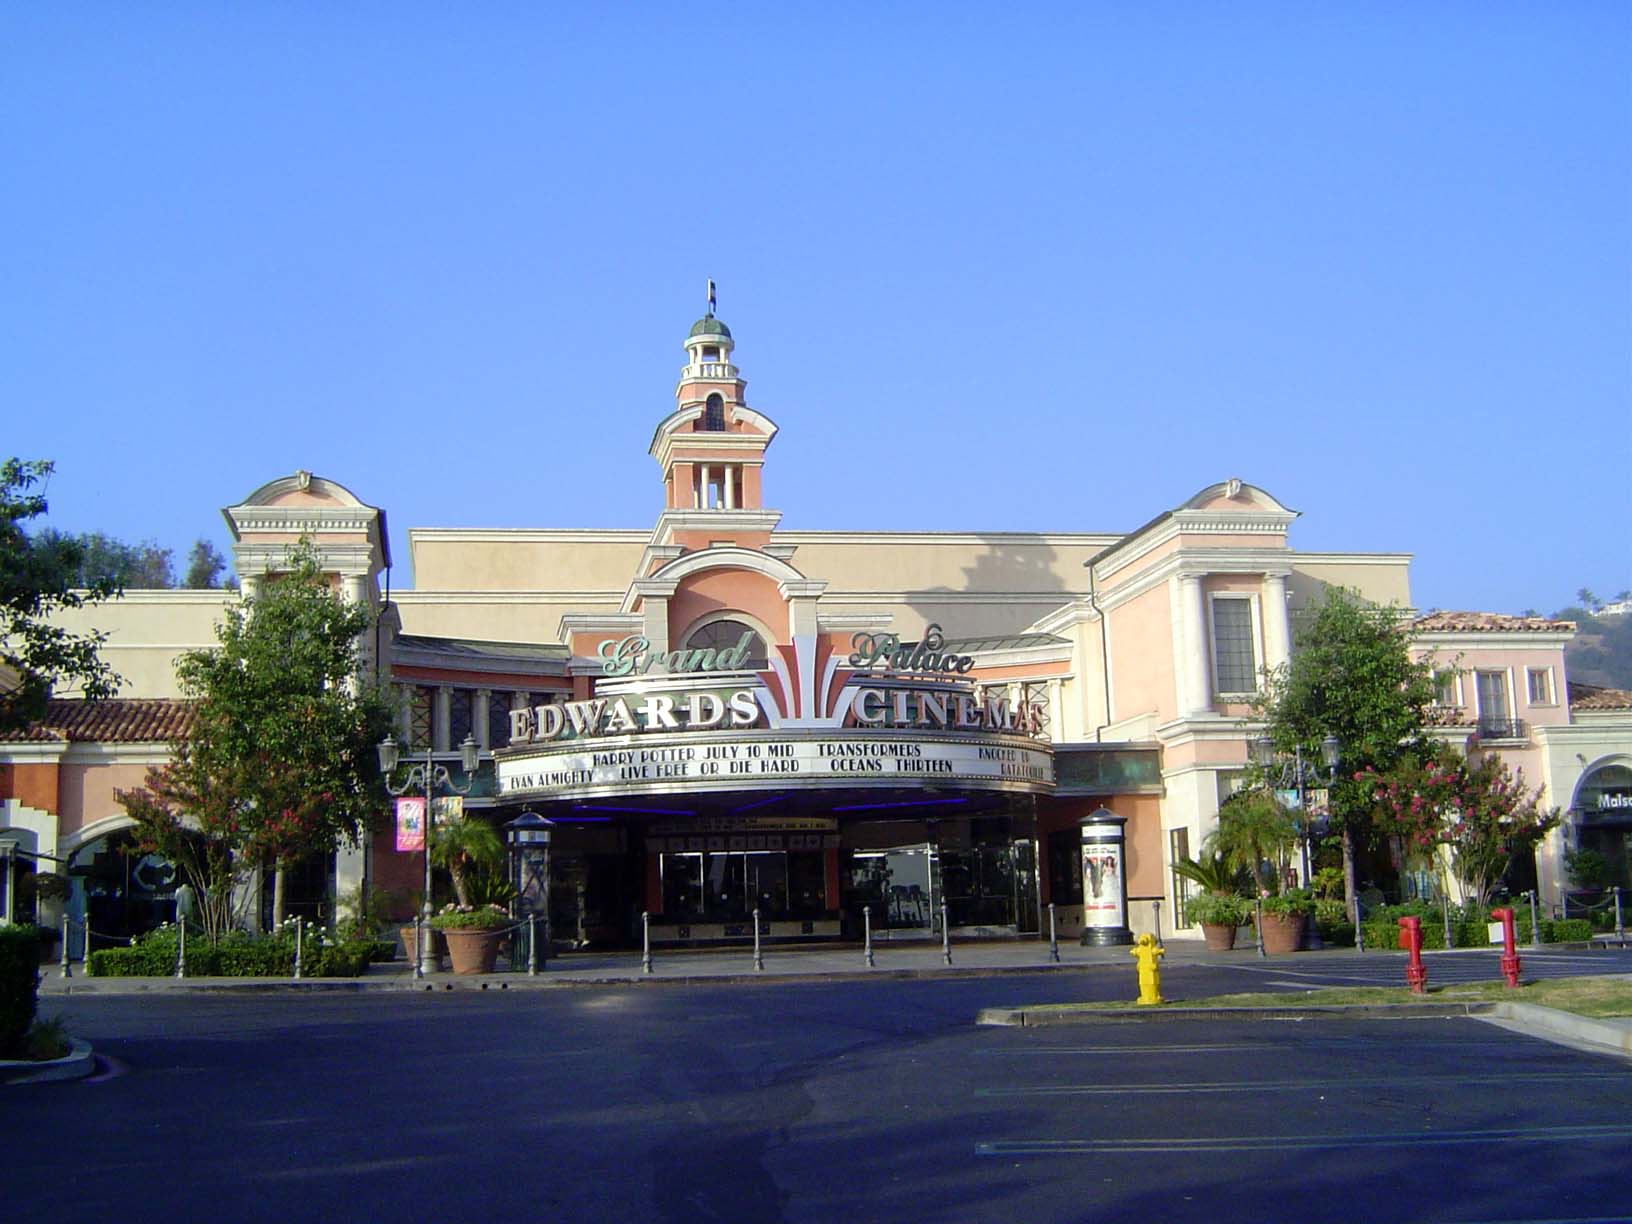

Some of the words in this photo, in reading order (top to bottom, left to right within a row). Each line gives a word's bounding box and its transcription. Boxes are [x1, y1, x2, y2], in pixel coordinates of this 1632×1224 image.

[598, 631, 756, 676] Grand
[849, 622, 976, 674] Palace
[509, 691, 759, 745] EDWARDS
[851, 687, 1044, 735] CINEMAS
[593, 751, 635, 767] HARRY
[641, 747, 695, 763] POTTER
[703, 746, 739, 760] JULY
[746, 744, 761, 759] 10
[768, 744, 794, 758] MID
[818, 743, 921, 757] TRANSFORMERS
[621, 765, 649, 780] LIVE
[656, 763, 689, 777] FREE
[700, 761, 719, 775] OR
[730, 760, 752, 774] DIE
[760, 759, 800, 773] HARD
[830, 758, 882, 772] OCEANS
[895, 759, 953, 773] THIRTEEN
[1001, 763, 1044, 780] RATATO
[511, 775, 533, 790] EVAN
[538, 769, 593, 787] ALMIGHTY
